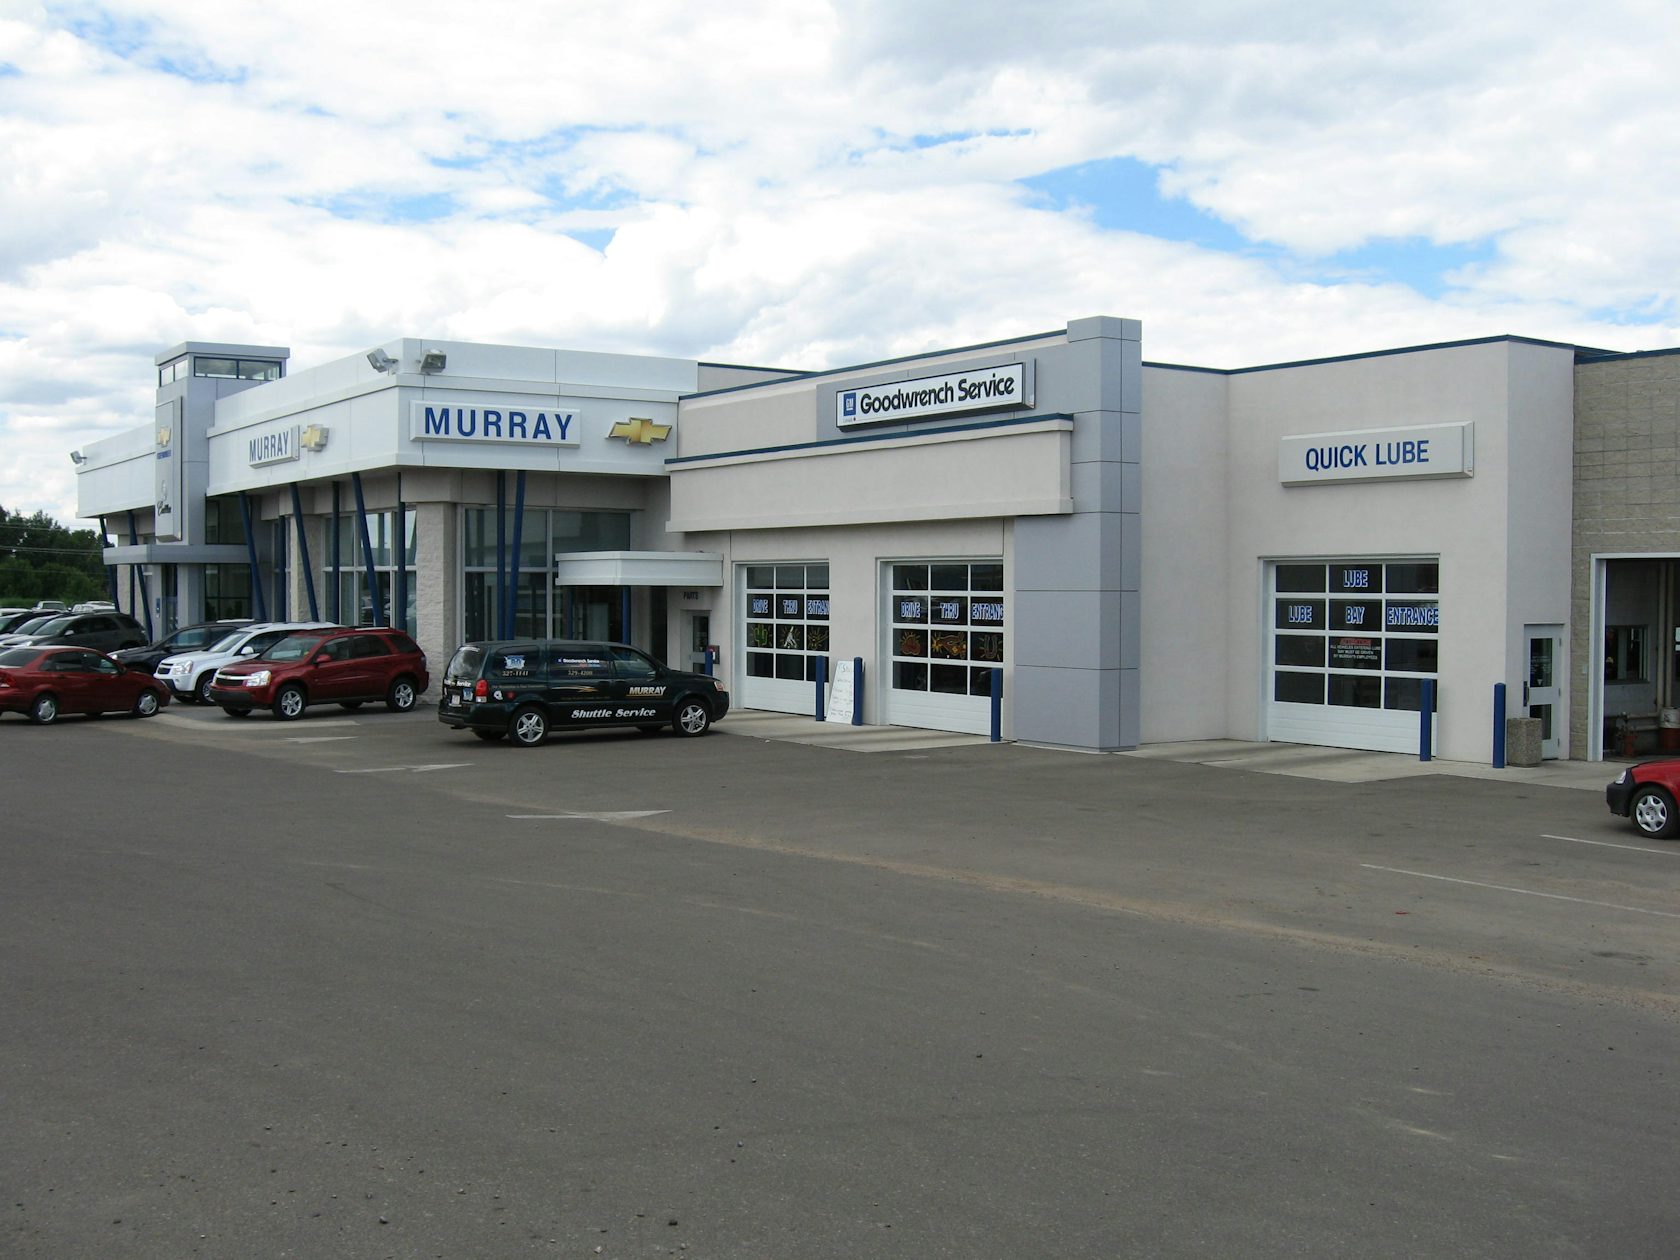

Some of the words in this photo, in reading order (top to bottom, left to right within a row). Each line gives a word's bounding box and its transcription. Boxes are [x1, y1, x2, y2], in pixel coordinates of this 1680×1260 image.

[860, 381, 954, 414] Goodwrench
[957, 373, 1015, 402] Service
[424, 407, 573, 440] MURRAY
[250, 431, 289, 462] MURRAY
[1305, 444, 1367, 472] QUICK
[1375, 440, 1429, 465] LUBE
[1343, 569, 1368, 588] LUBE
[752, 599, 769, 614] DRIVE
[782, 599, 798, 615] THRU
[807, 600, 829, 615] ENTRAN
[900, 602, 921, 618] DRIVE
[939, 602, 960, 619] THRU
[971, 603, 1003, 620] ENTRANC
[1288, 605, 1312, 623] LUBE
[1345, 606, 1366, 624] BAY
[1386, 606, 1439, 625] ENTRANCE
[628, 686, 667, 696] MURRAY
[571, 708, 612, 719] Shuttle
[615, 707, 657, 718] Service
